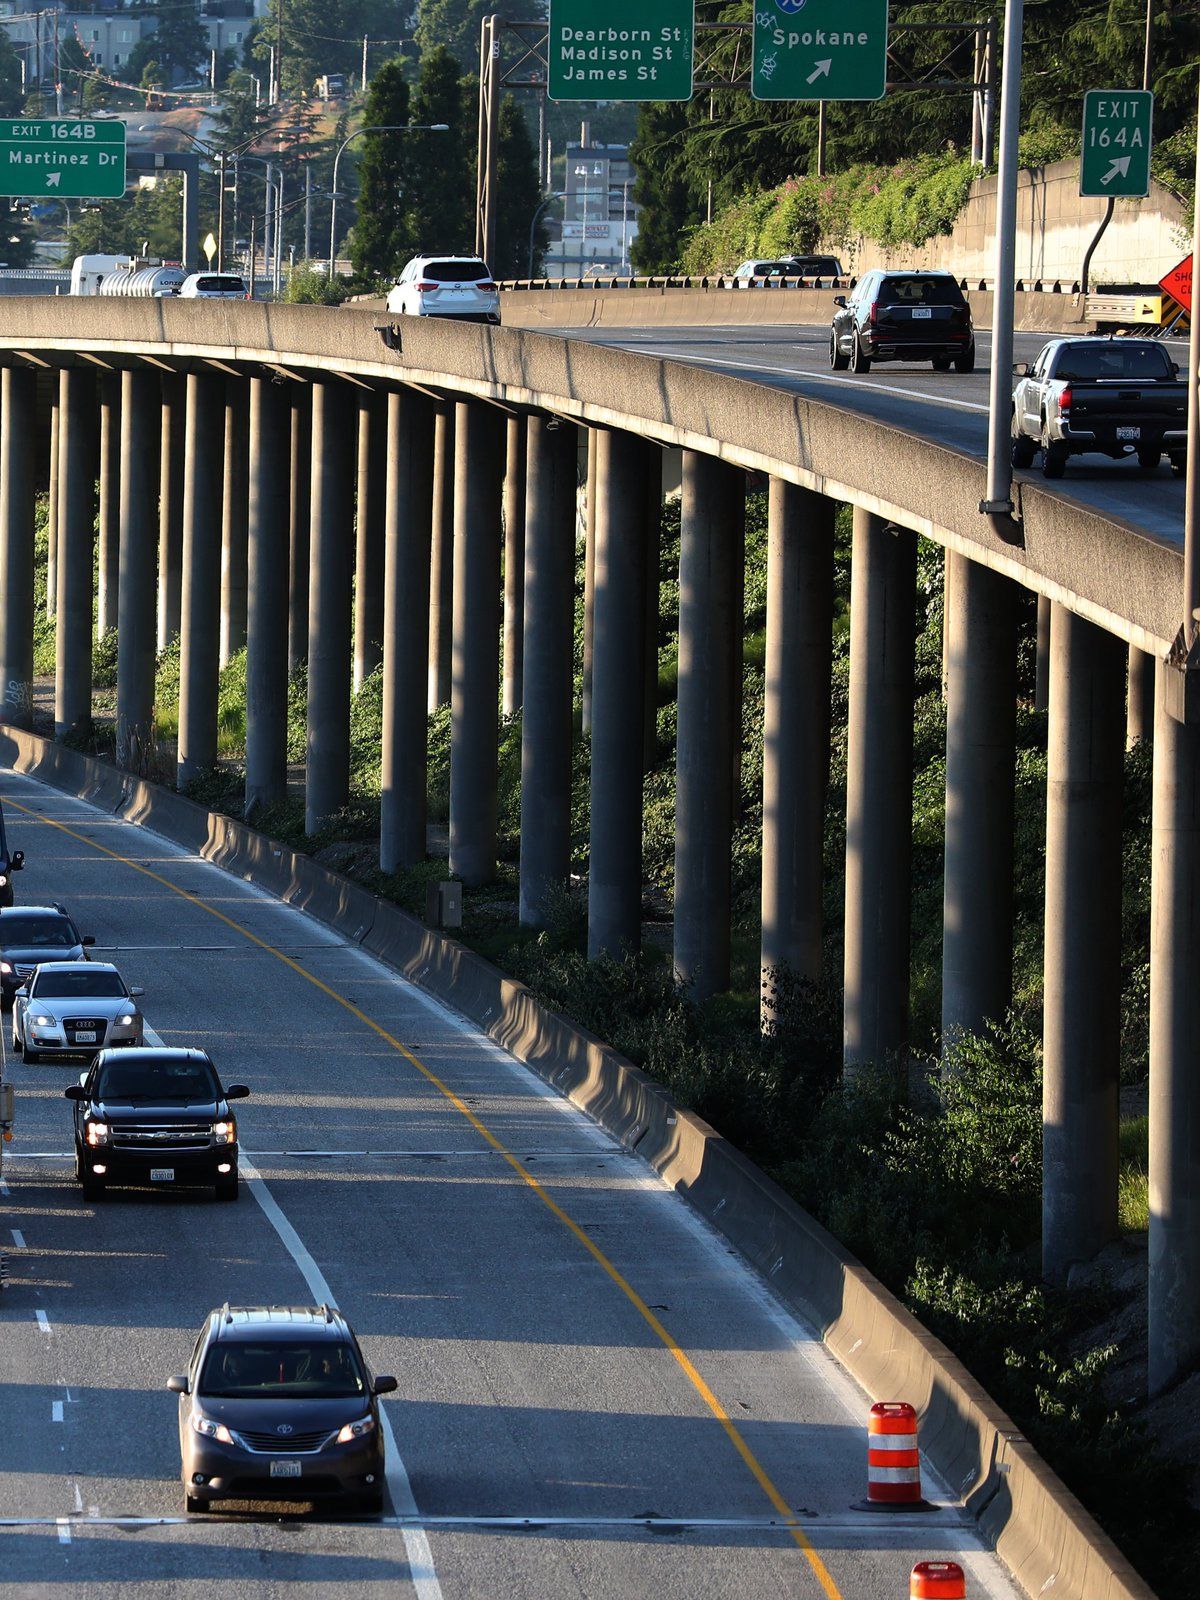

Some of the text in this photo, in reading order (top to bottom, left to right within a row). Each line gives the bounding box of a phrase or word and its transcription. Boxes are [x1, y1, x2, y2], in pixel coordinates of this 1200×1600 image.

[561, 27, 681, 42] Dearborn St
[772, 29, 868, 49] Spokane
[561, 46, 673, 61] Madison St
[563, 66, 658, 81] James St
[1097, 101, 1139, 118] EXIT
[12, 124, 96, 139] EXIT 164B
[1090, 127, 1143, 148] 164A
[10, 150, 89, 165] Martinez
[98, 152, 118, 165] Dr
